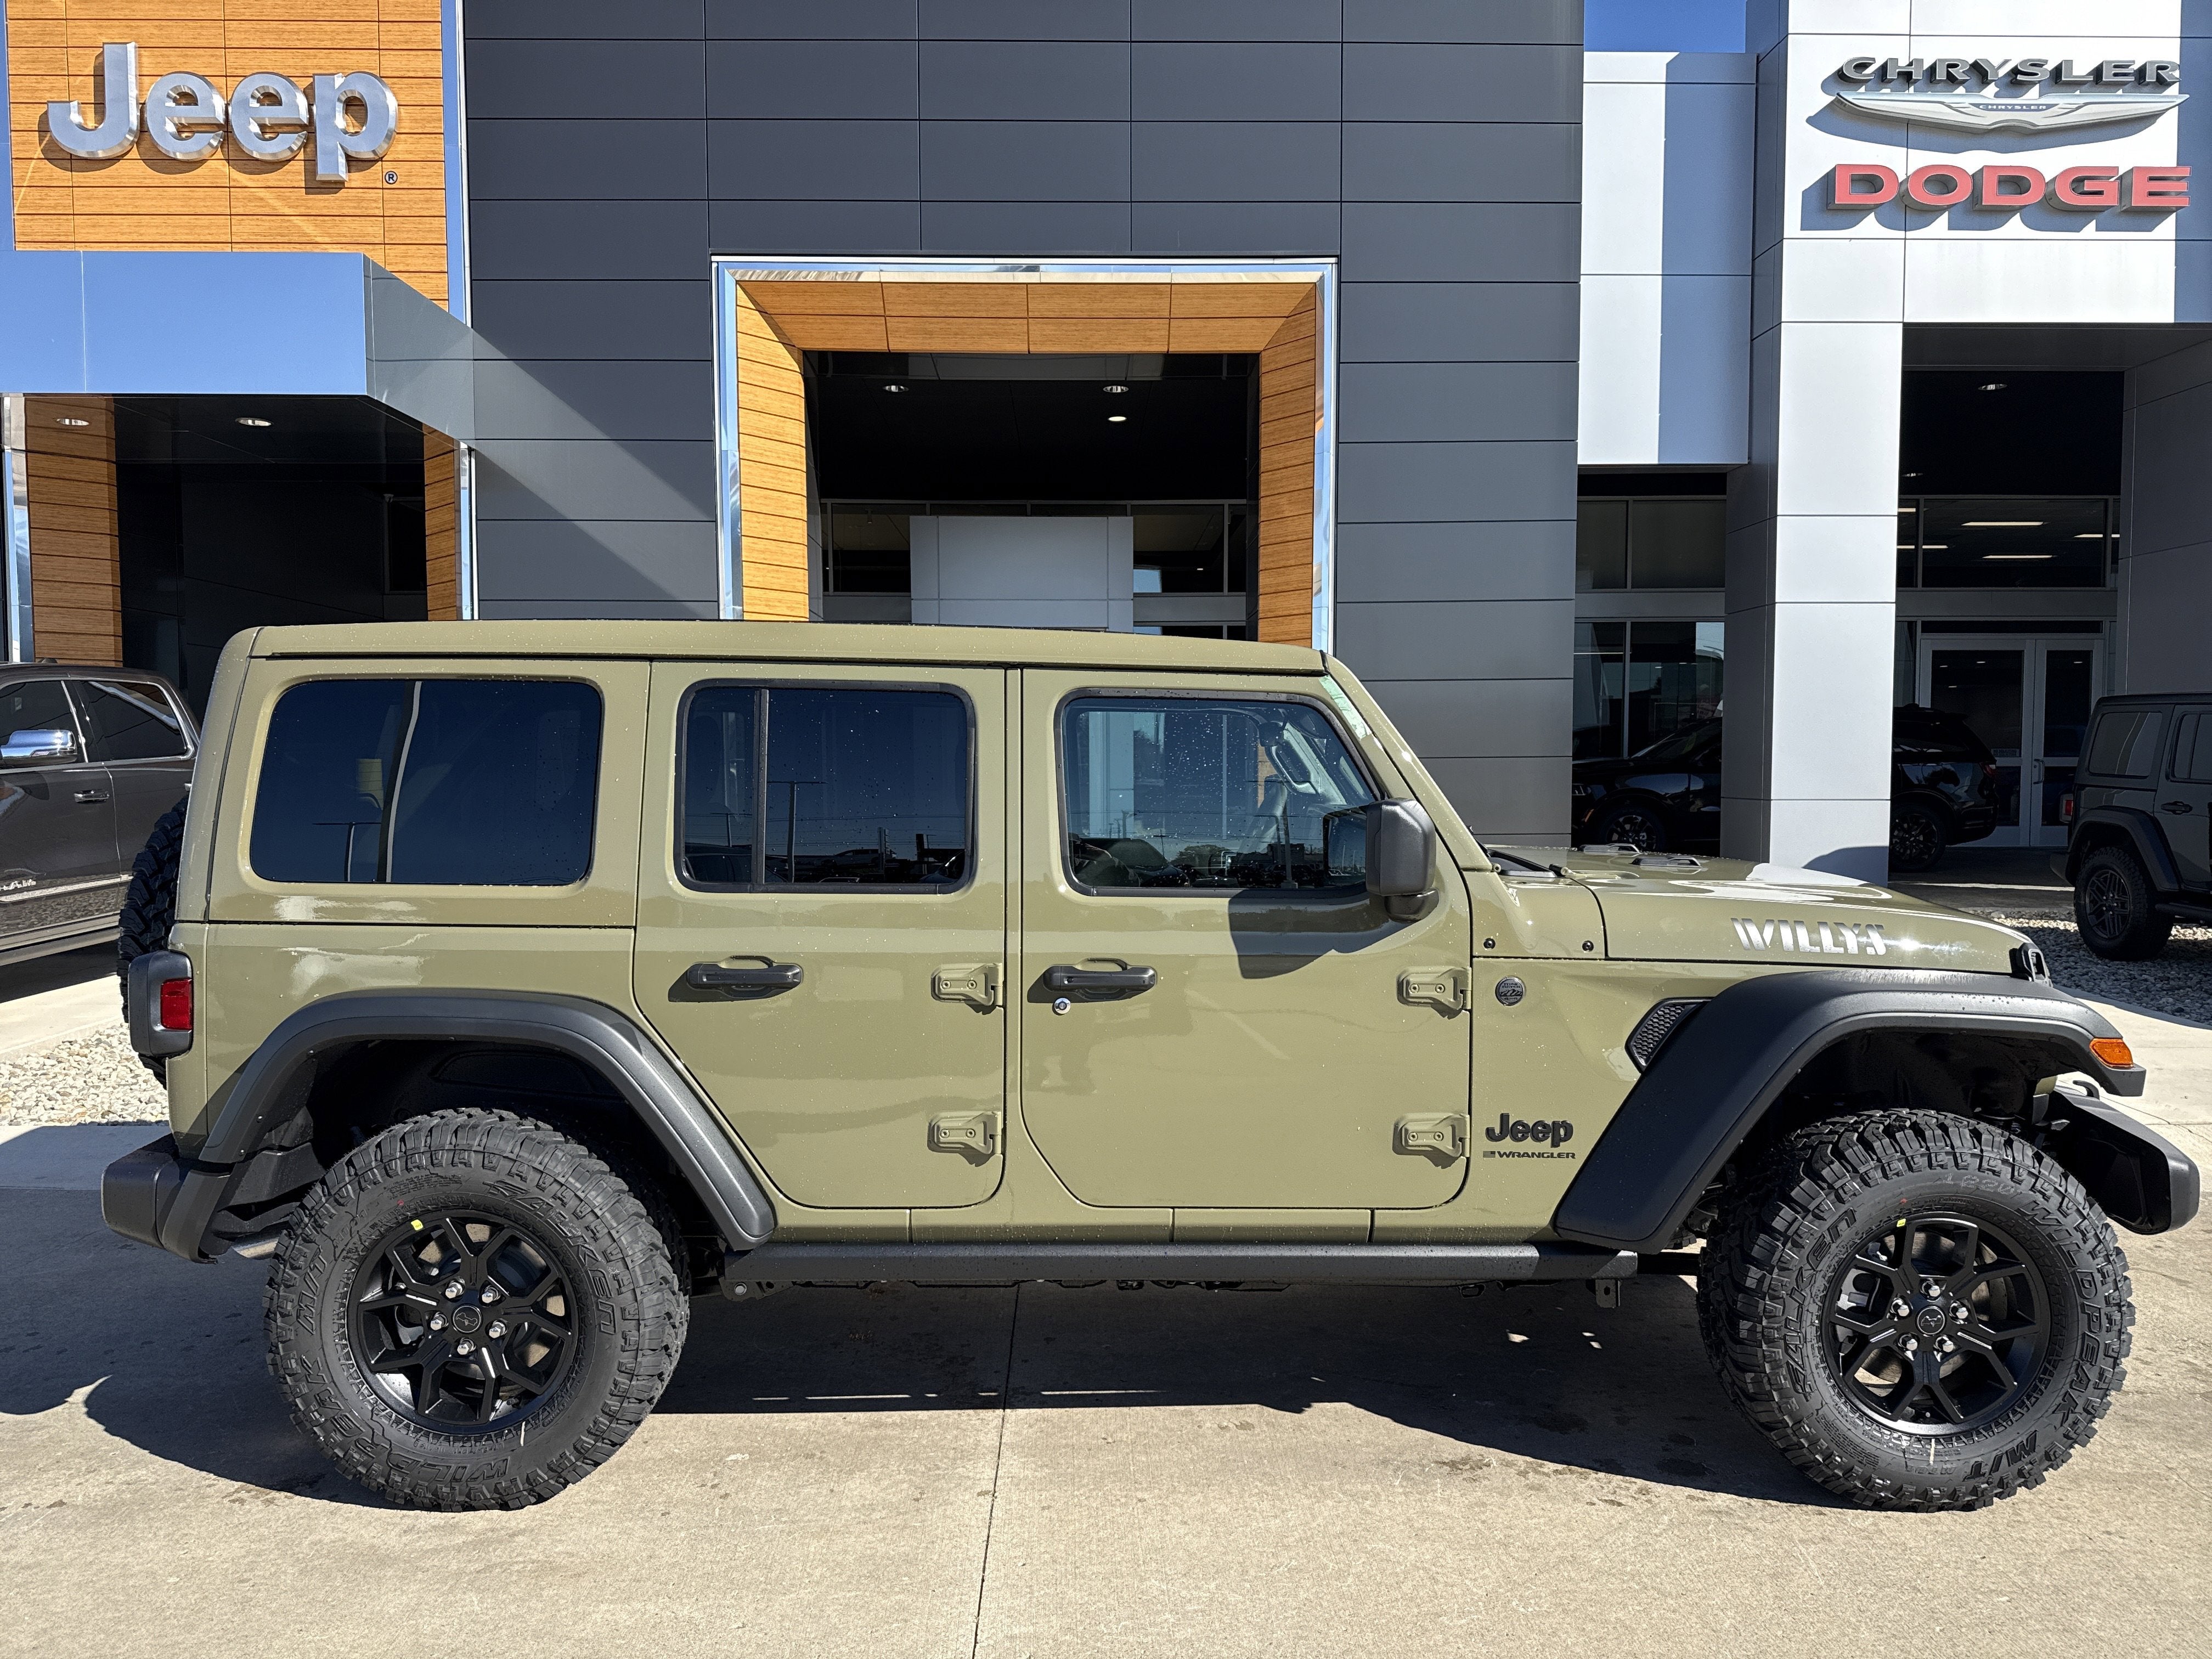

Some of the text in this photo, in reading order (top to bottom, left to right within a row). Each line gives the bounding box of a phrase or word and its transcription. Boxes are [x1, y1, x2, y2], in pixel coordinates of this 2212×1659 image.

[1837, 56, 2181, 86] CHRYSLER
[47, 41, 398, 183] Jeep
[1830, 163, 2192, 211] DODGE
[1730, 917, 1887, 956] WILLYS
[1486, 1113, 1573, 1148] Jeep
[1497, 1150, 1576, 1159] WRANGLER
[1783, 1206, 1858, 1402] FALKEN
[2019, 1200, 2103, 1427] WILDPEAK
[1962, 1430, 2039, 1482] M/T
